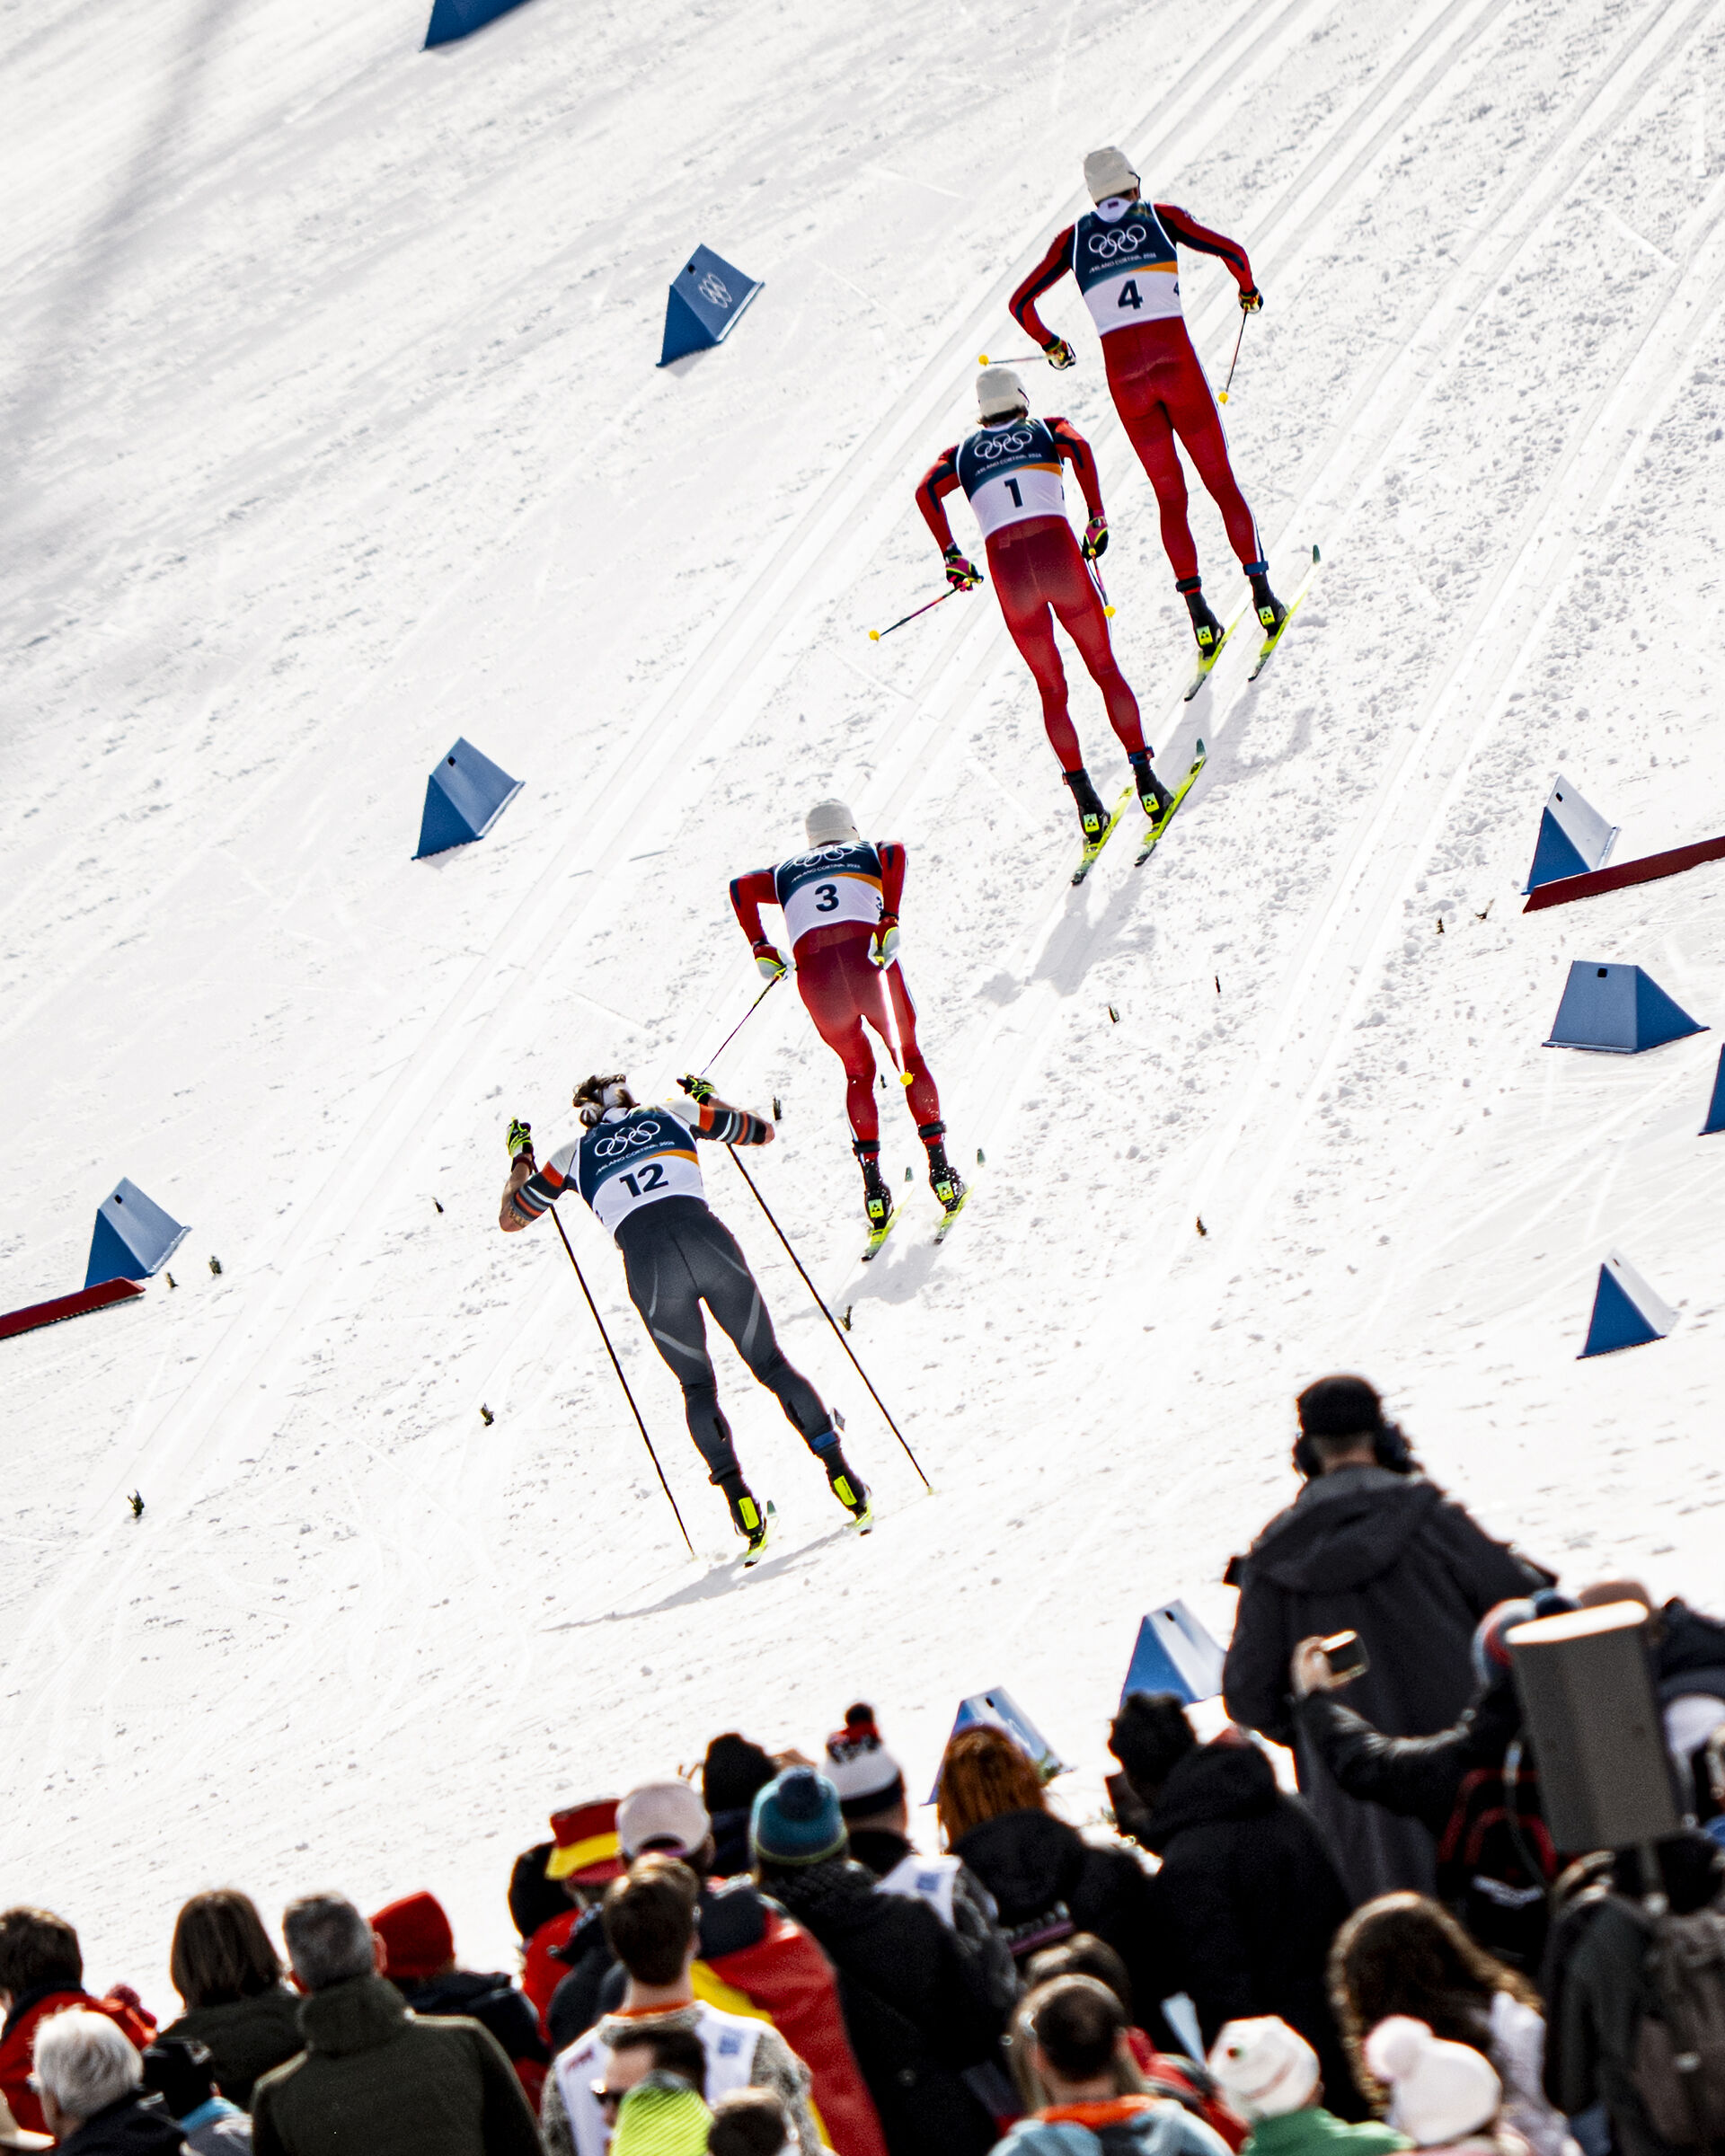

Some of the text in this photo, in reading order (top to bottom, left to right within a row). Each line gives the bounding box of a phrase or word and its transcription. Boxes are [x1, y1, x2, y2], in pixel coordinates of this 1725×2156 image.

[1118, 278, 1144, 310] 4
[1004, 477, 1023, 508] 1
[814, 883, 840, 912] 3
[618, 1163, 669, 1197] 12
